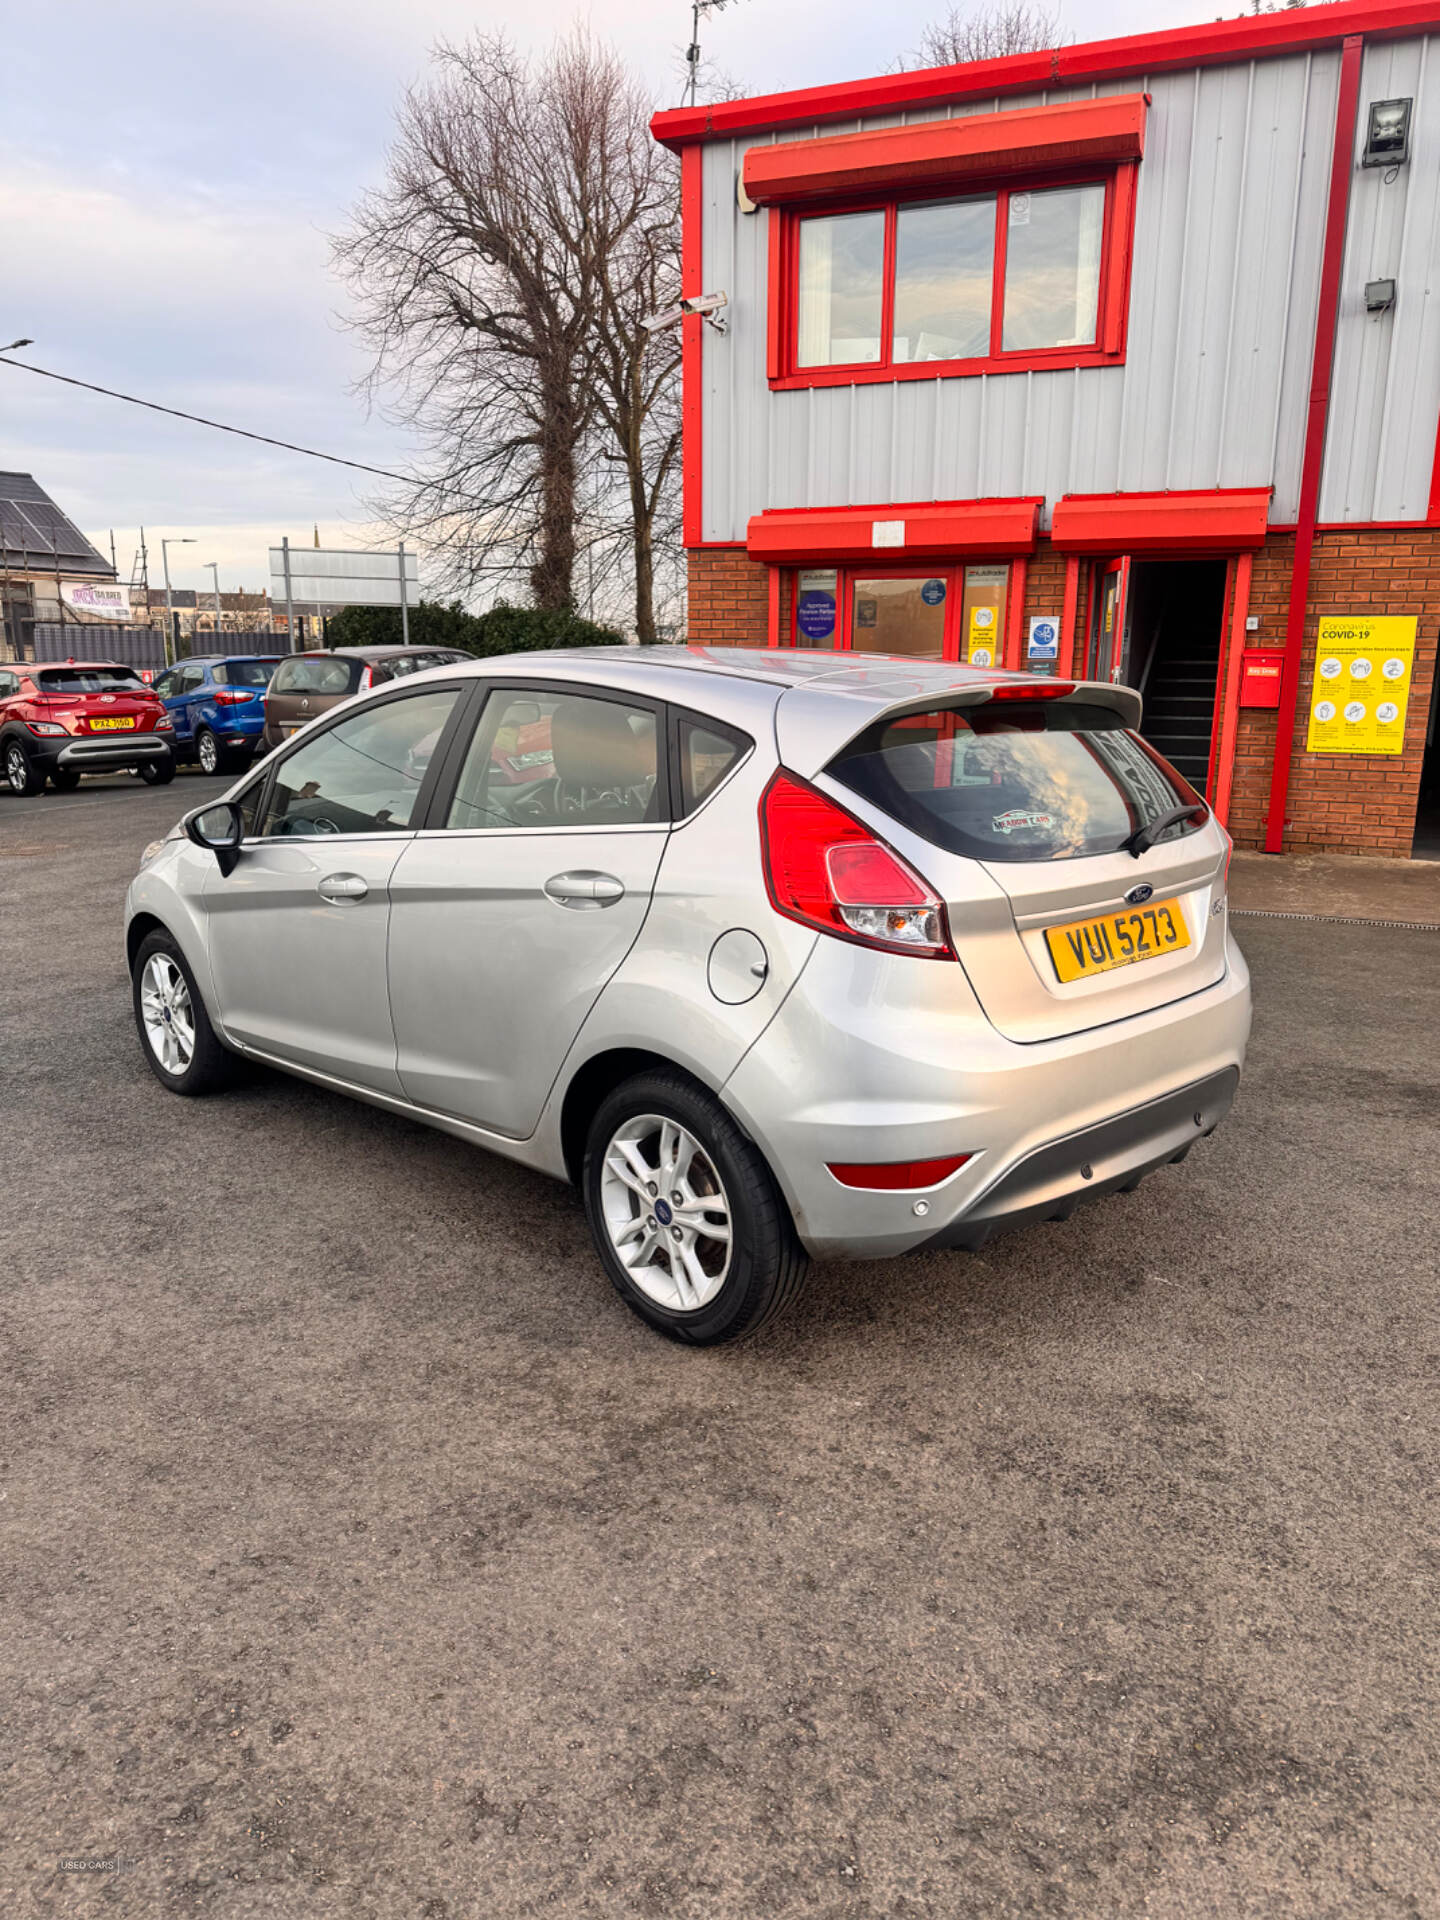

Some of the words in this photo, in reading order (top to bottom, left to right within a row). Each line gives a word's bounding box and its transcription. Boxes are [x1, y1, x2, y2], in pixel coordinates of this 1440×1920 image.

[1322, 621, 1376, 631] Coronavirus
[1321, 630, 1371, 640] COVID-19
[1065, 923, 1115, 969] VUI
[1114, 907, 1177, 956] 5273
